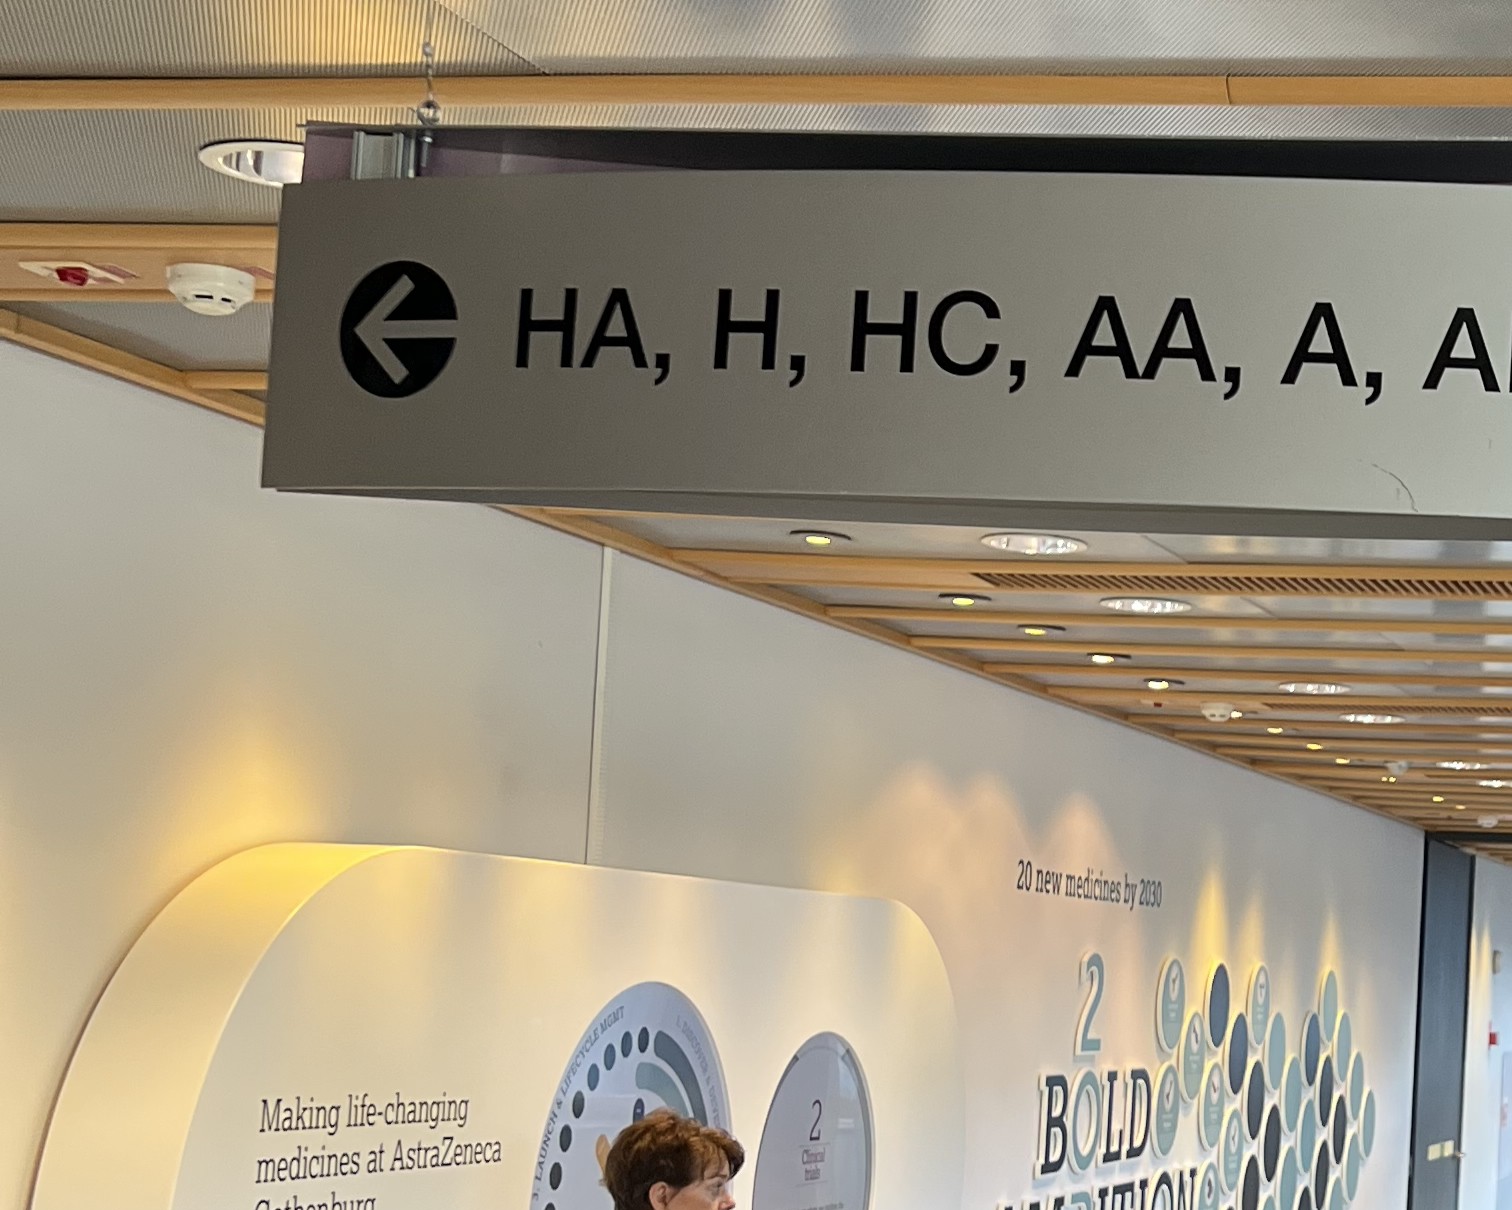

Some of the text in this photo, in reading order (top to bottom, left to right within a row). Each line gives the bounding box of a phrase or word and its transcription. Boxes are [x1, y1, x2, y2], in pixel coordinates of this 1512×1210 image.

[514, 286, 671, 386] HA,
[713, 288, 806, 388] H,
[849, 290, 1027, 393] HC,
[1064, 295, 1242, 401] AA,
[1280, 302, 1383, 406] A,
[1016, 859, 1163, 911] 20 new medicines by 2030
[259, 1092, 470, 1135] Making life-changing
[534, 1112, 559, 1182] LAUNCH
[560, 1026, 601, 1097] LIFECYCLE
[809, 1099, 822, 1141] 2
[1037, 1068, 1151, 1176] BOLD
[255, 1136, 502, 1184] medicines at AstraZeneca
